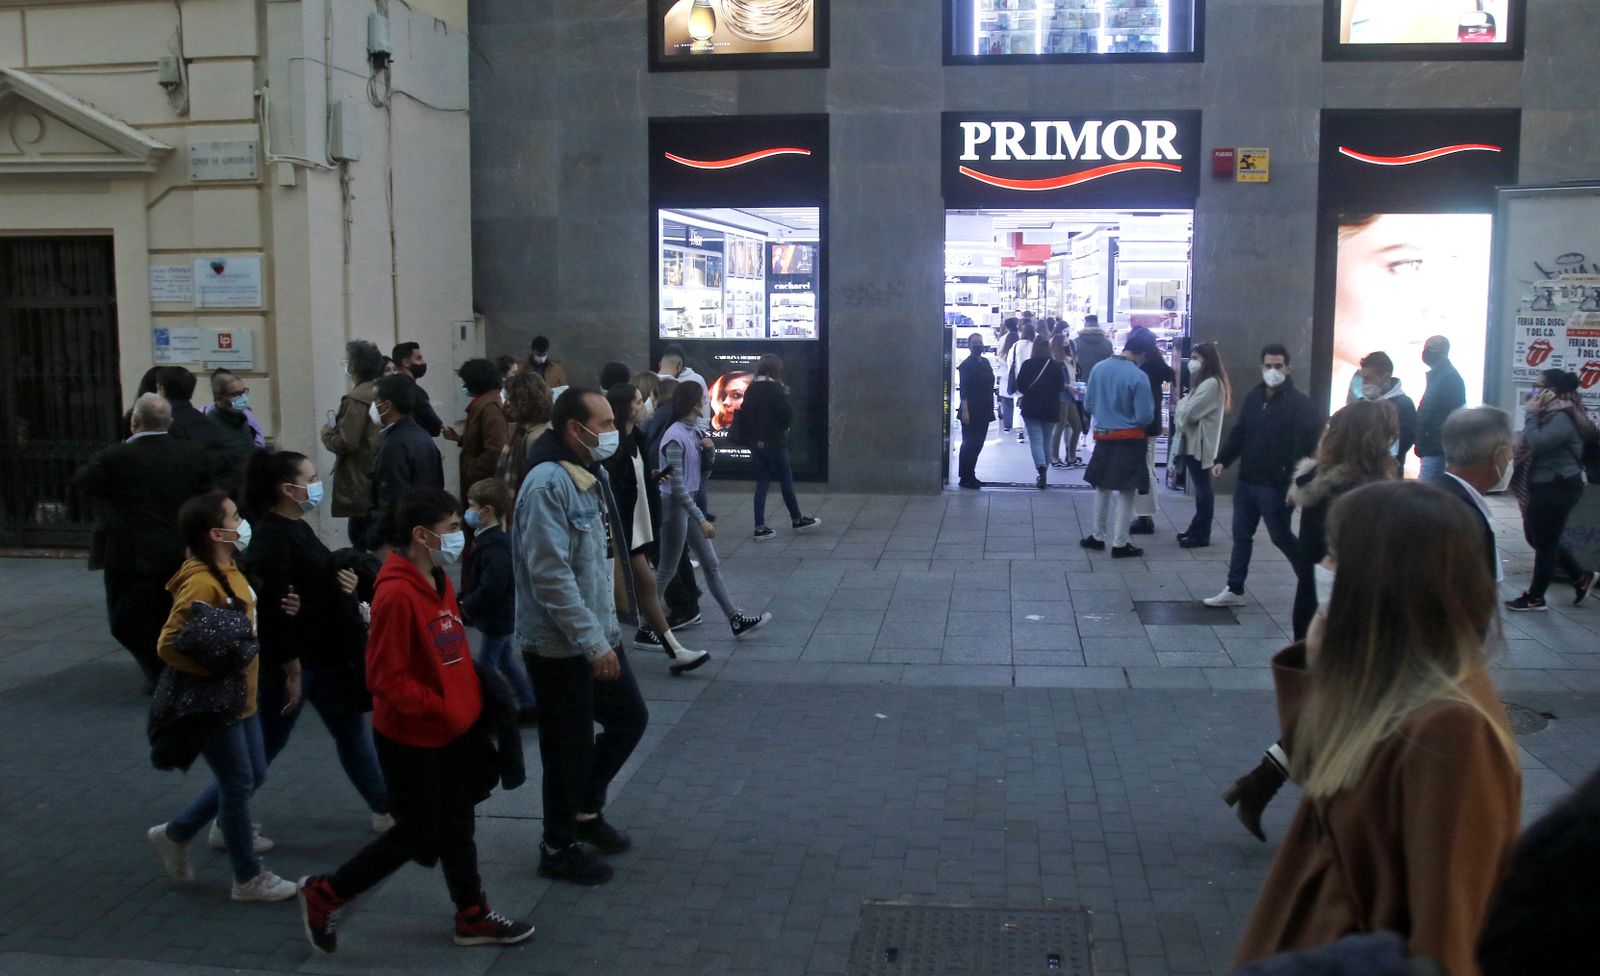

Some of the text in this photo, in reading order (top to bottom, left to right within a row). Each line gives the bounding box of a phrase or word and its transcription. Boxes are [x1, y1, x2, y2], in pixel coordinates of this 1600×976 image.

[960, 120, 1182, 160] PRIMOR
[773, 281, 811, 290] cacharel
[1517, 317, 1566, 327] FERIA DEL DISCO
[1526, 328, 1556, 337] Y DEL C.D.
[1568, 338, 1598, 348] FERIA DEL
[1583, 349, 1595, 358] DEL
